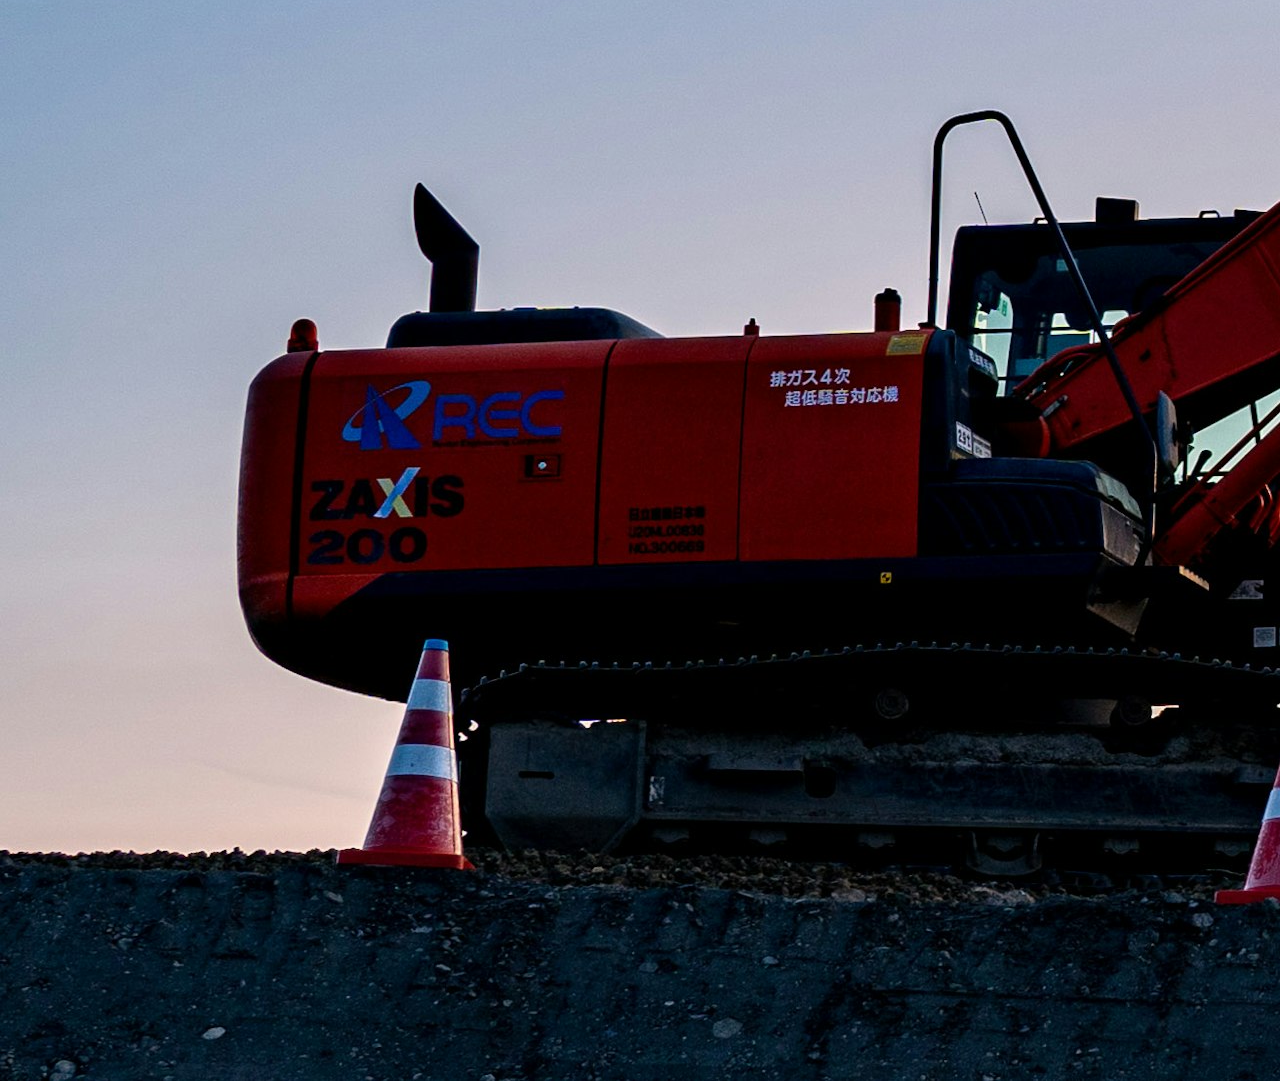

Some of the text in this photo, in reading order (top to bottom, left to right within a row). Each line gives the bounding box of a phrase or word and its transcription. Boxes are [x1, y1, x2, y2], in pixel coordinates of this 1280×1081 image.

[432, 390, 565, 440] REC
[784, 385, 899, 407] 超低騒音対応機
[310, 467, 464, 519] ZAXIS
[308, 527, 427, 564] 200
